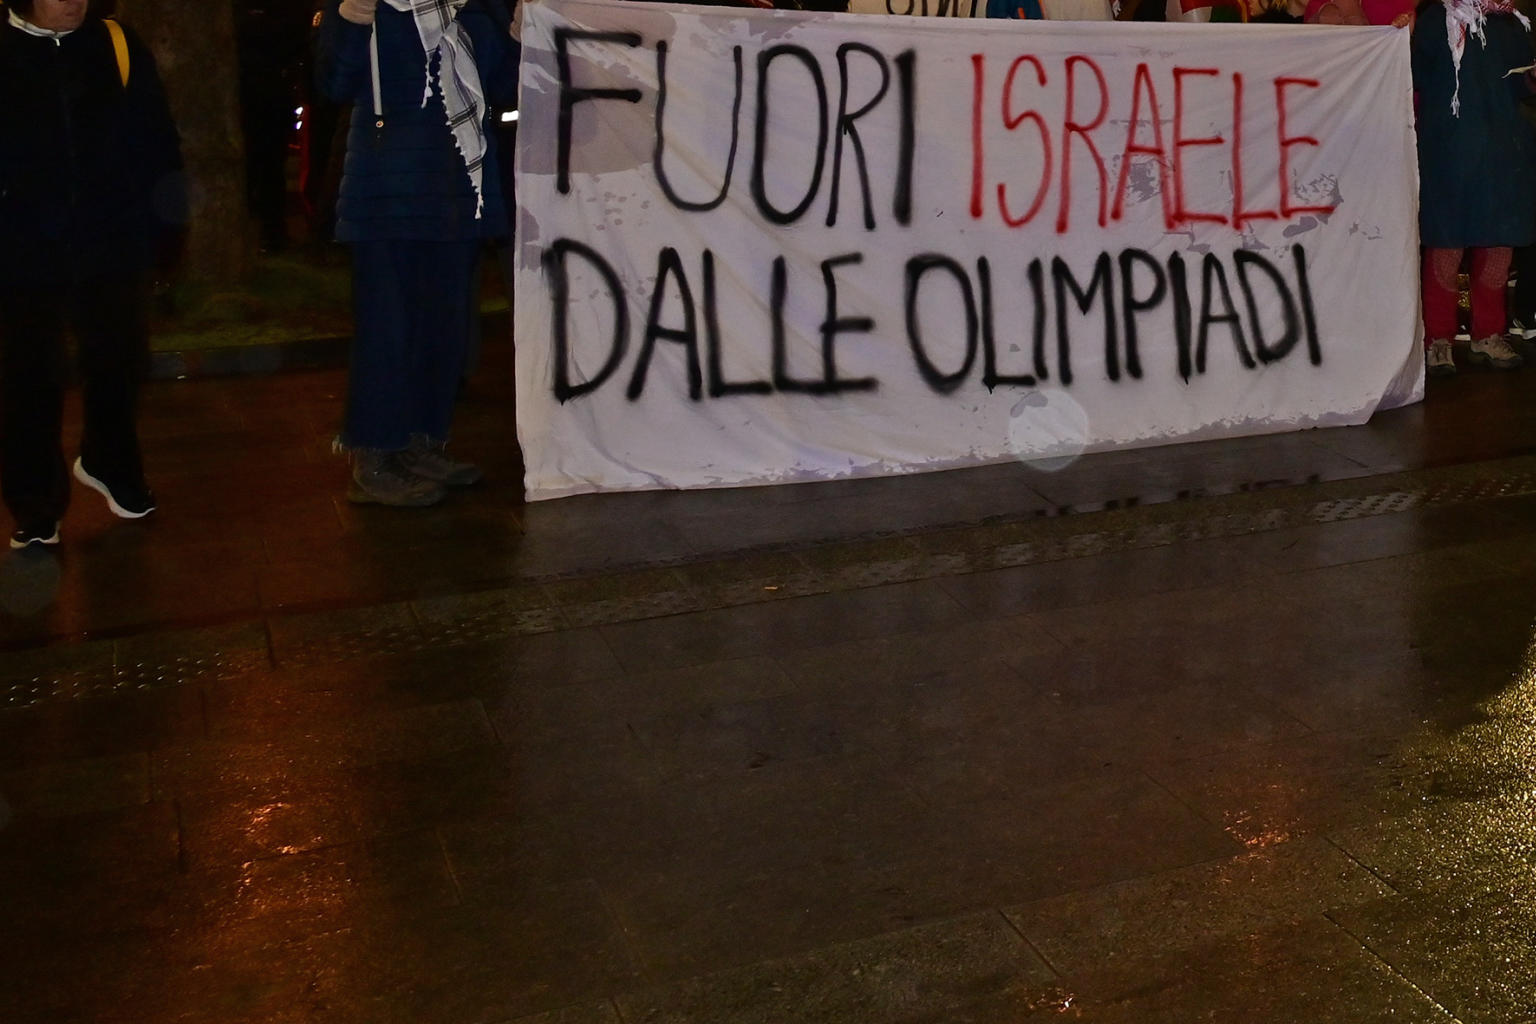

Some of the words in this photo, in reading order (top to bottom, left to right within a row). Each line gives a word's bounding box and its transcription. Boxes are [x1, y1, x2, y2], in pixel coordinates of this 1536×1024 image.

[552, 26, 917, 229] FUORI
[968, 51, 1337, 234] ISRAELE
[541, 237, 878, 404] DALLE
[904, 241, 1324, 394] OLIMPIADI
